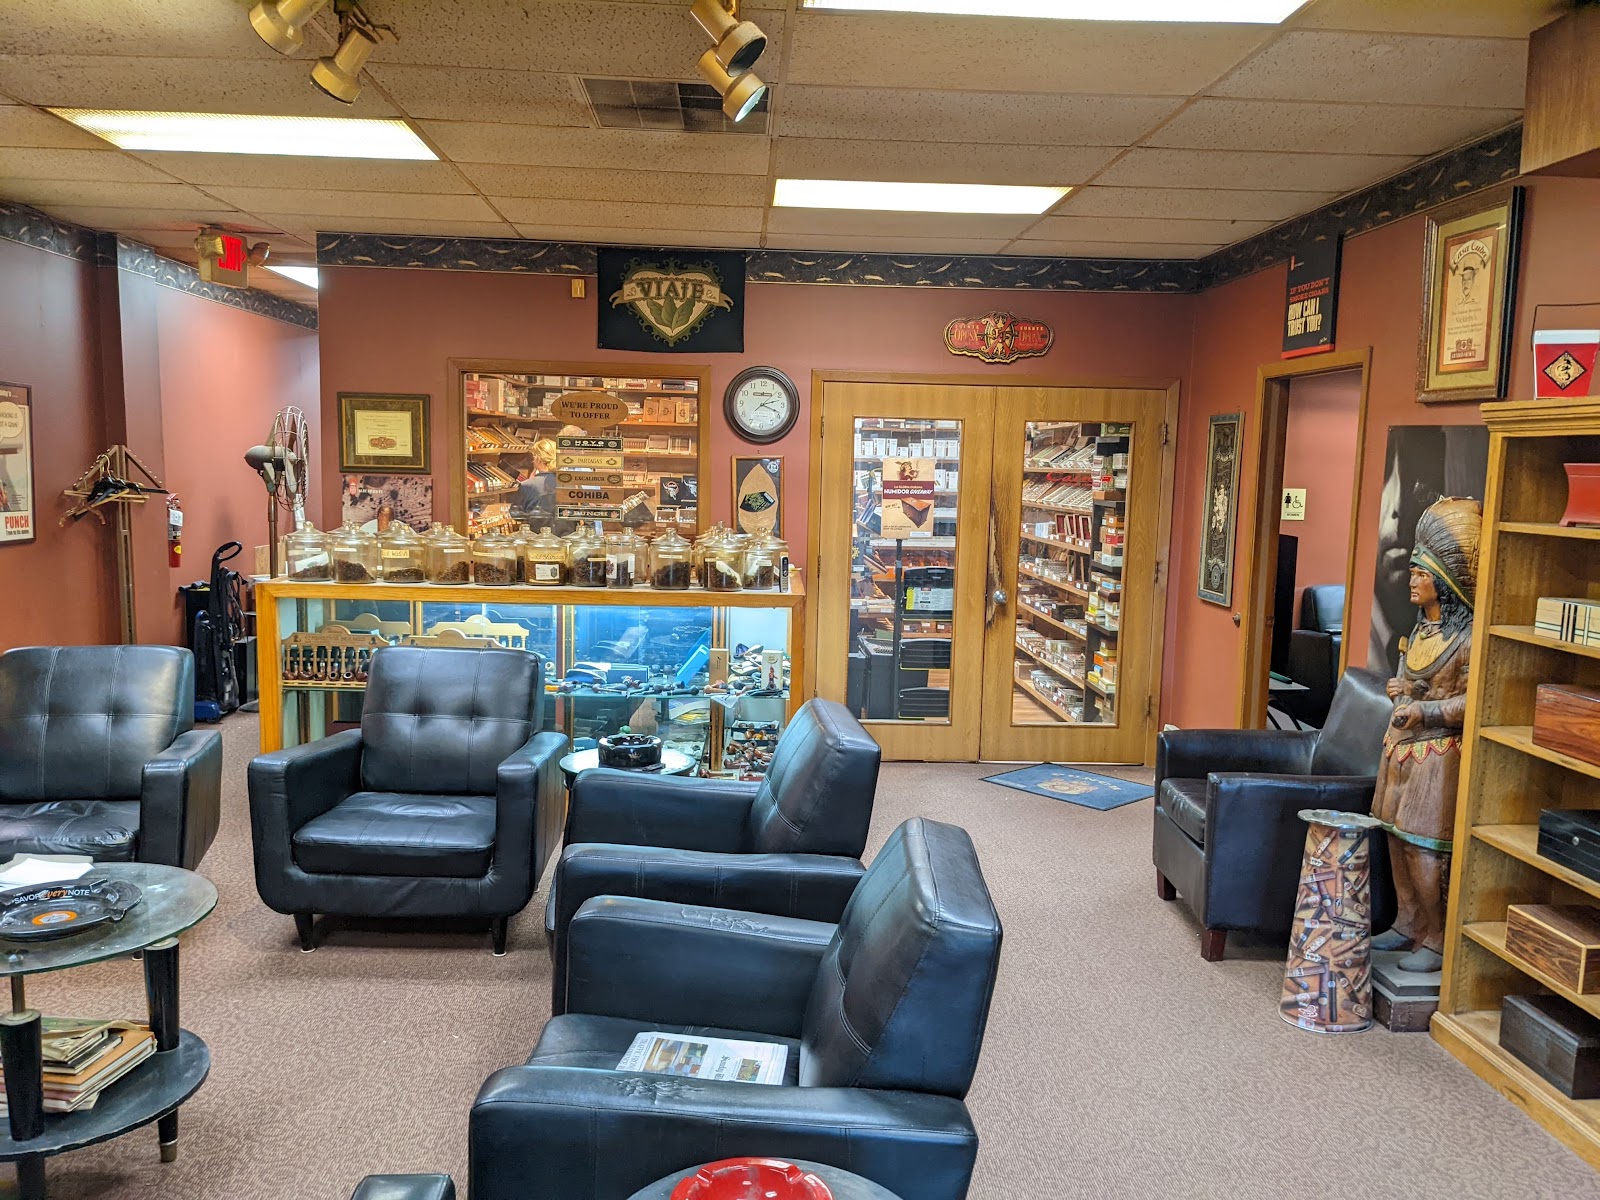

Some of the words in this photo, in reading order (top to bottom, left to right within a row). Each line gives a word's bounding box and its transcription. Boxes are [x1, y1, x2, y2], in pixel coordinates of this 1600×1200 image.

[1453, 246, 1470, 265] Casa
[1471, 241, 1487, 258] Cuba
[635, 281, 705, 301] VIAJE
[1298, 283, 1310, 292] YOU
[1288, 301, 1303, 320] HOW
[1303, 298, 1316, 317] CAN
[1288, 317, 1306, 337] TRUST
[1306, 313, 1322, 333] YOU?
[561, 401, 588, 409] WE'RE
[590, 402, 619, 410] PROUD
[570, 411, 582, 419] TO
[583, 412, 610, 420] OFFER
[568, 490, 610, 500] COHIBA
[5, 515, 29, 529] PUNCH
[14, 893, 41, 904] SAVOR
